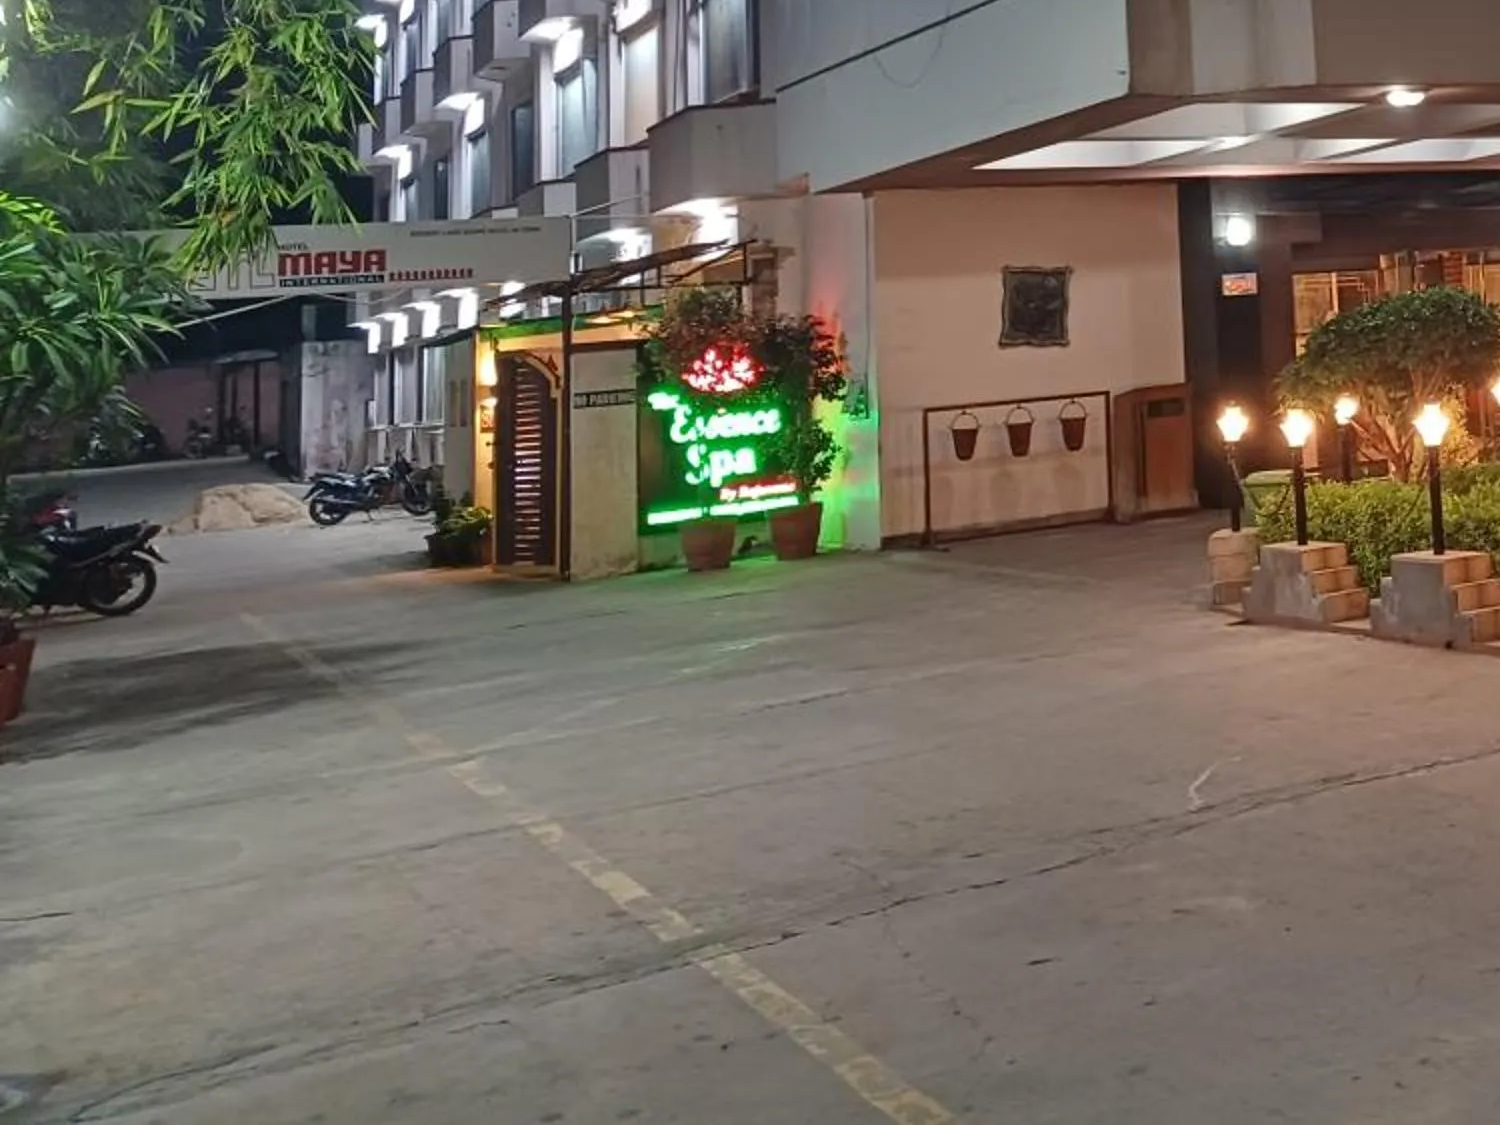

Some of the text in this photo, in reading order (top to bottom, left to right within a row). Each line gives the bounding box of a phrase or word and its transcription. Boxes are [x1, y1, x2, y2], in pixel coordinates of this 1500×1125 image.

[277, 248, 386, 277] MAYA
[280, 274, 385, 287] INTERNATIONAL
[686, 443, 757, 487] Spa
